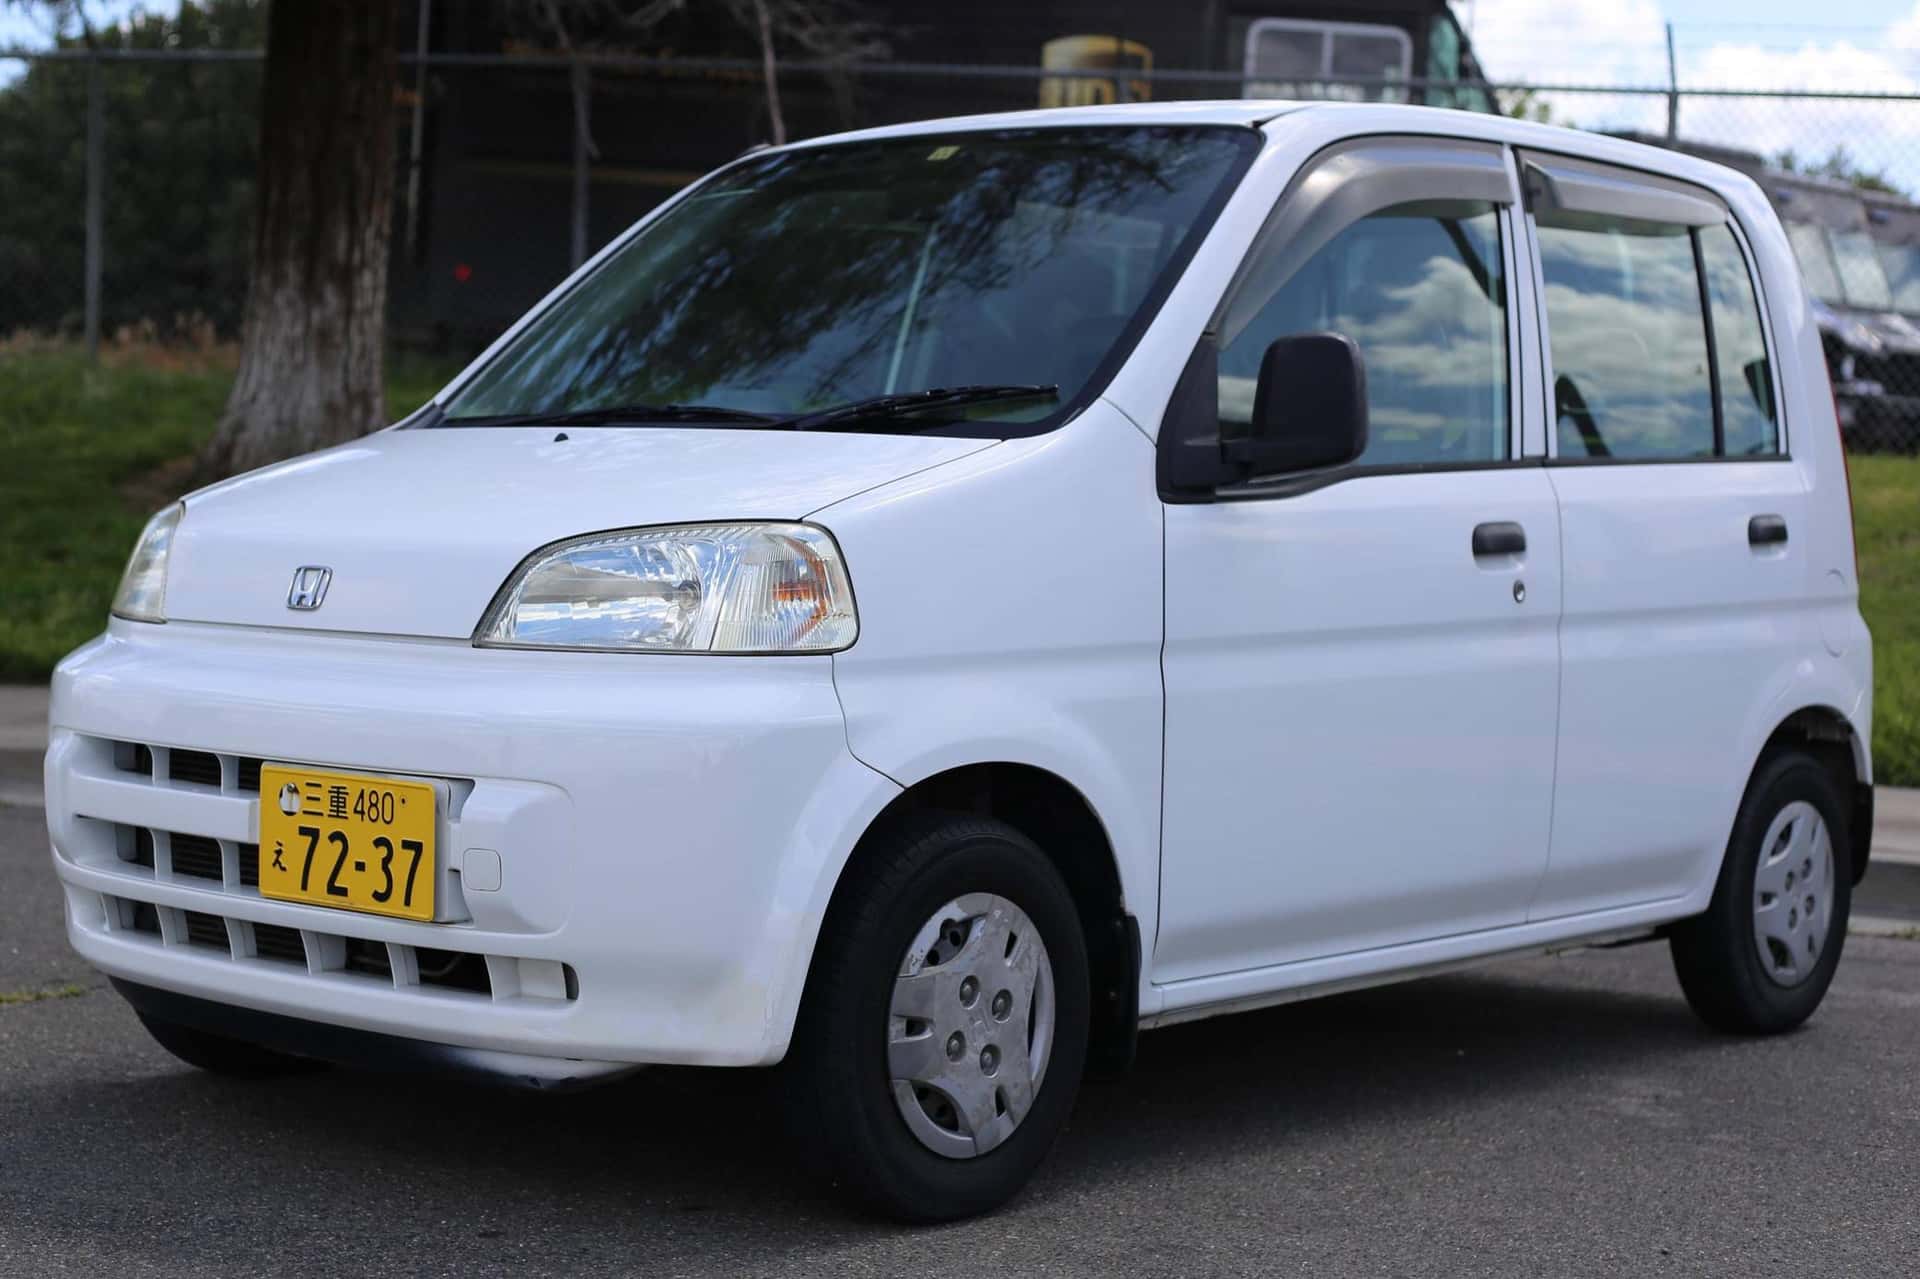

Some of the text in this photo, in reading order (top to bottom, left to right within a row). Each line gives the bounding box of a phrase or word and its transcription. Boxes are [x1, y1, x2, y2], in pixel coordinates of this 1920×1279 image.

[302, 781, 395, 825] 三重 480
[272, 825, 424, 908] え 72-37
